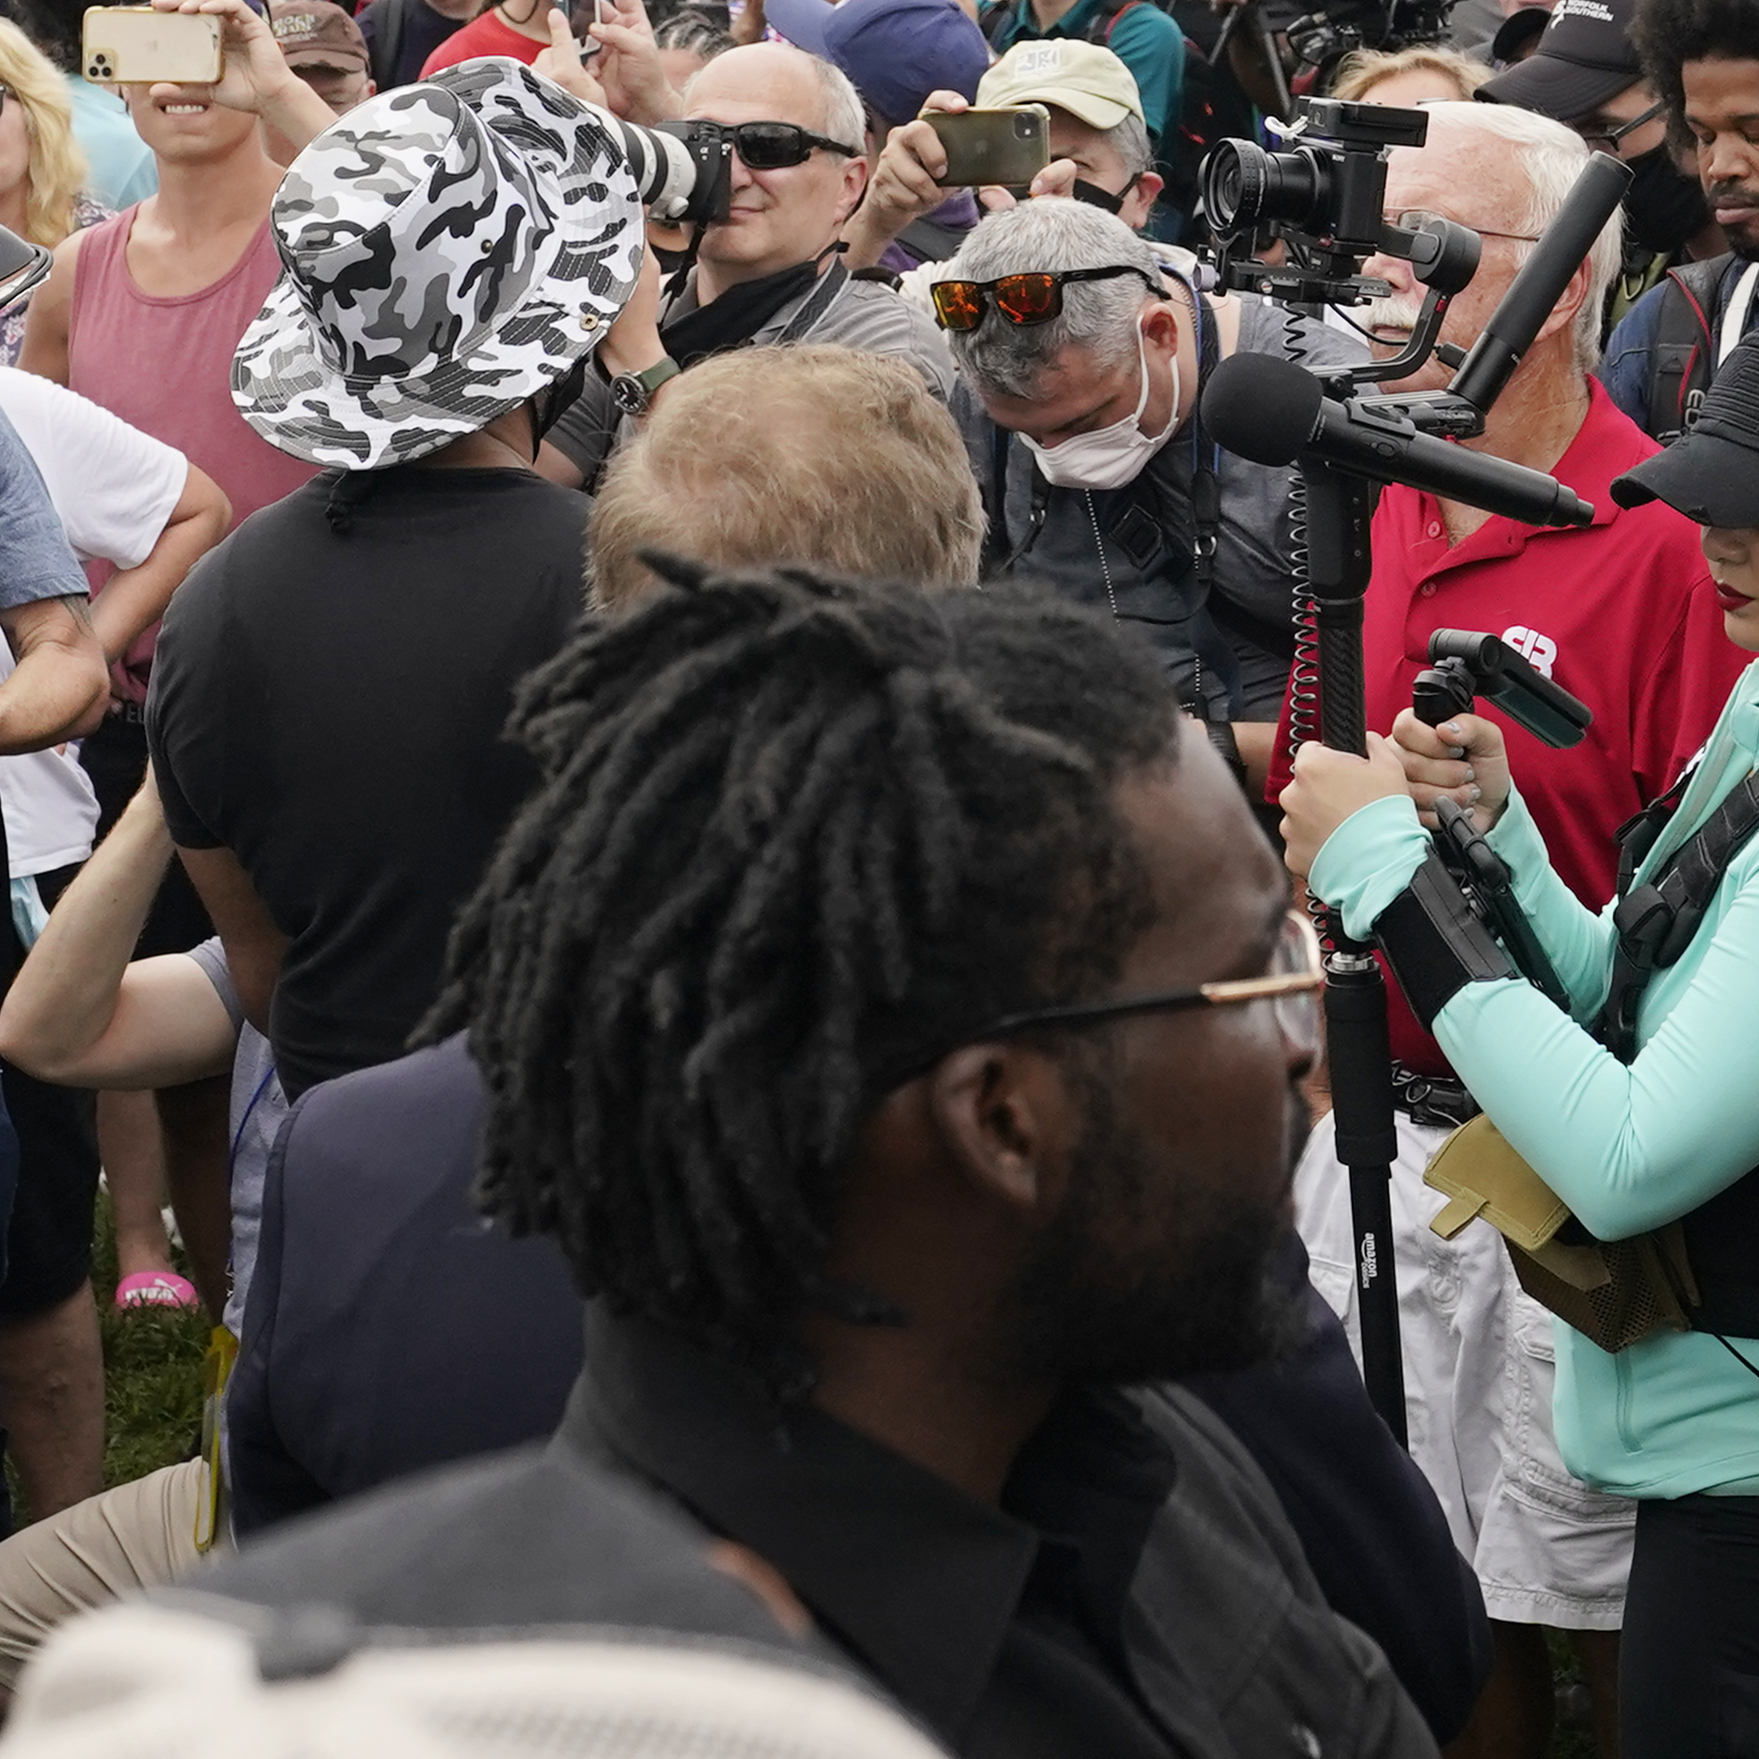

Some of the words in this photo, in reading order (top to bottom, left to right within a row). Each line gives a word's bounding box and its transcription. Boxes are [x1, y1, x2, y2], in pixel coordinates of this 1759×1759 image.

[1567, 0, 1609, 12] NORFOLK
[1565, 7, 1614, 21] SOUTHERN
[1361, 1233, 1378, 1277] amazon
